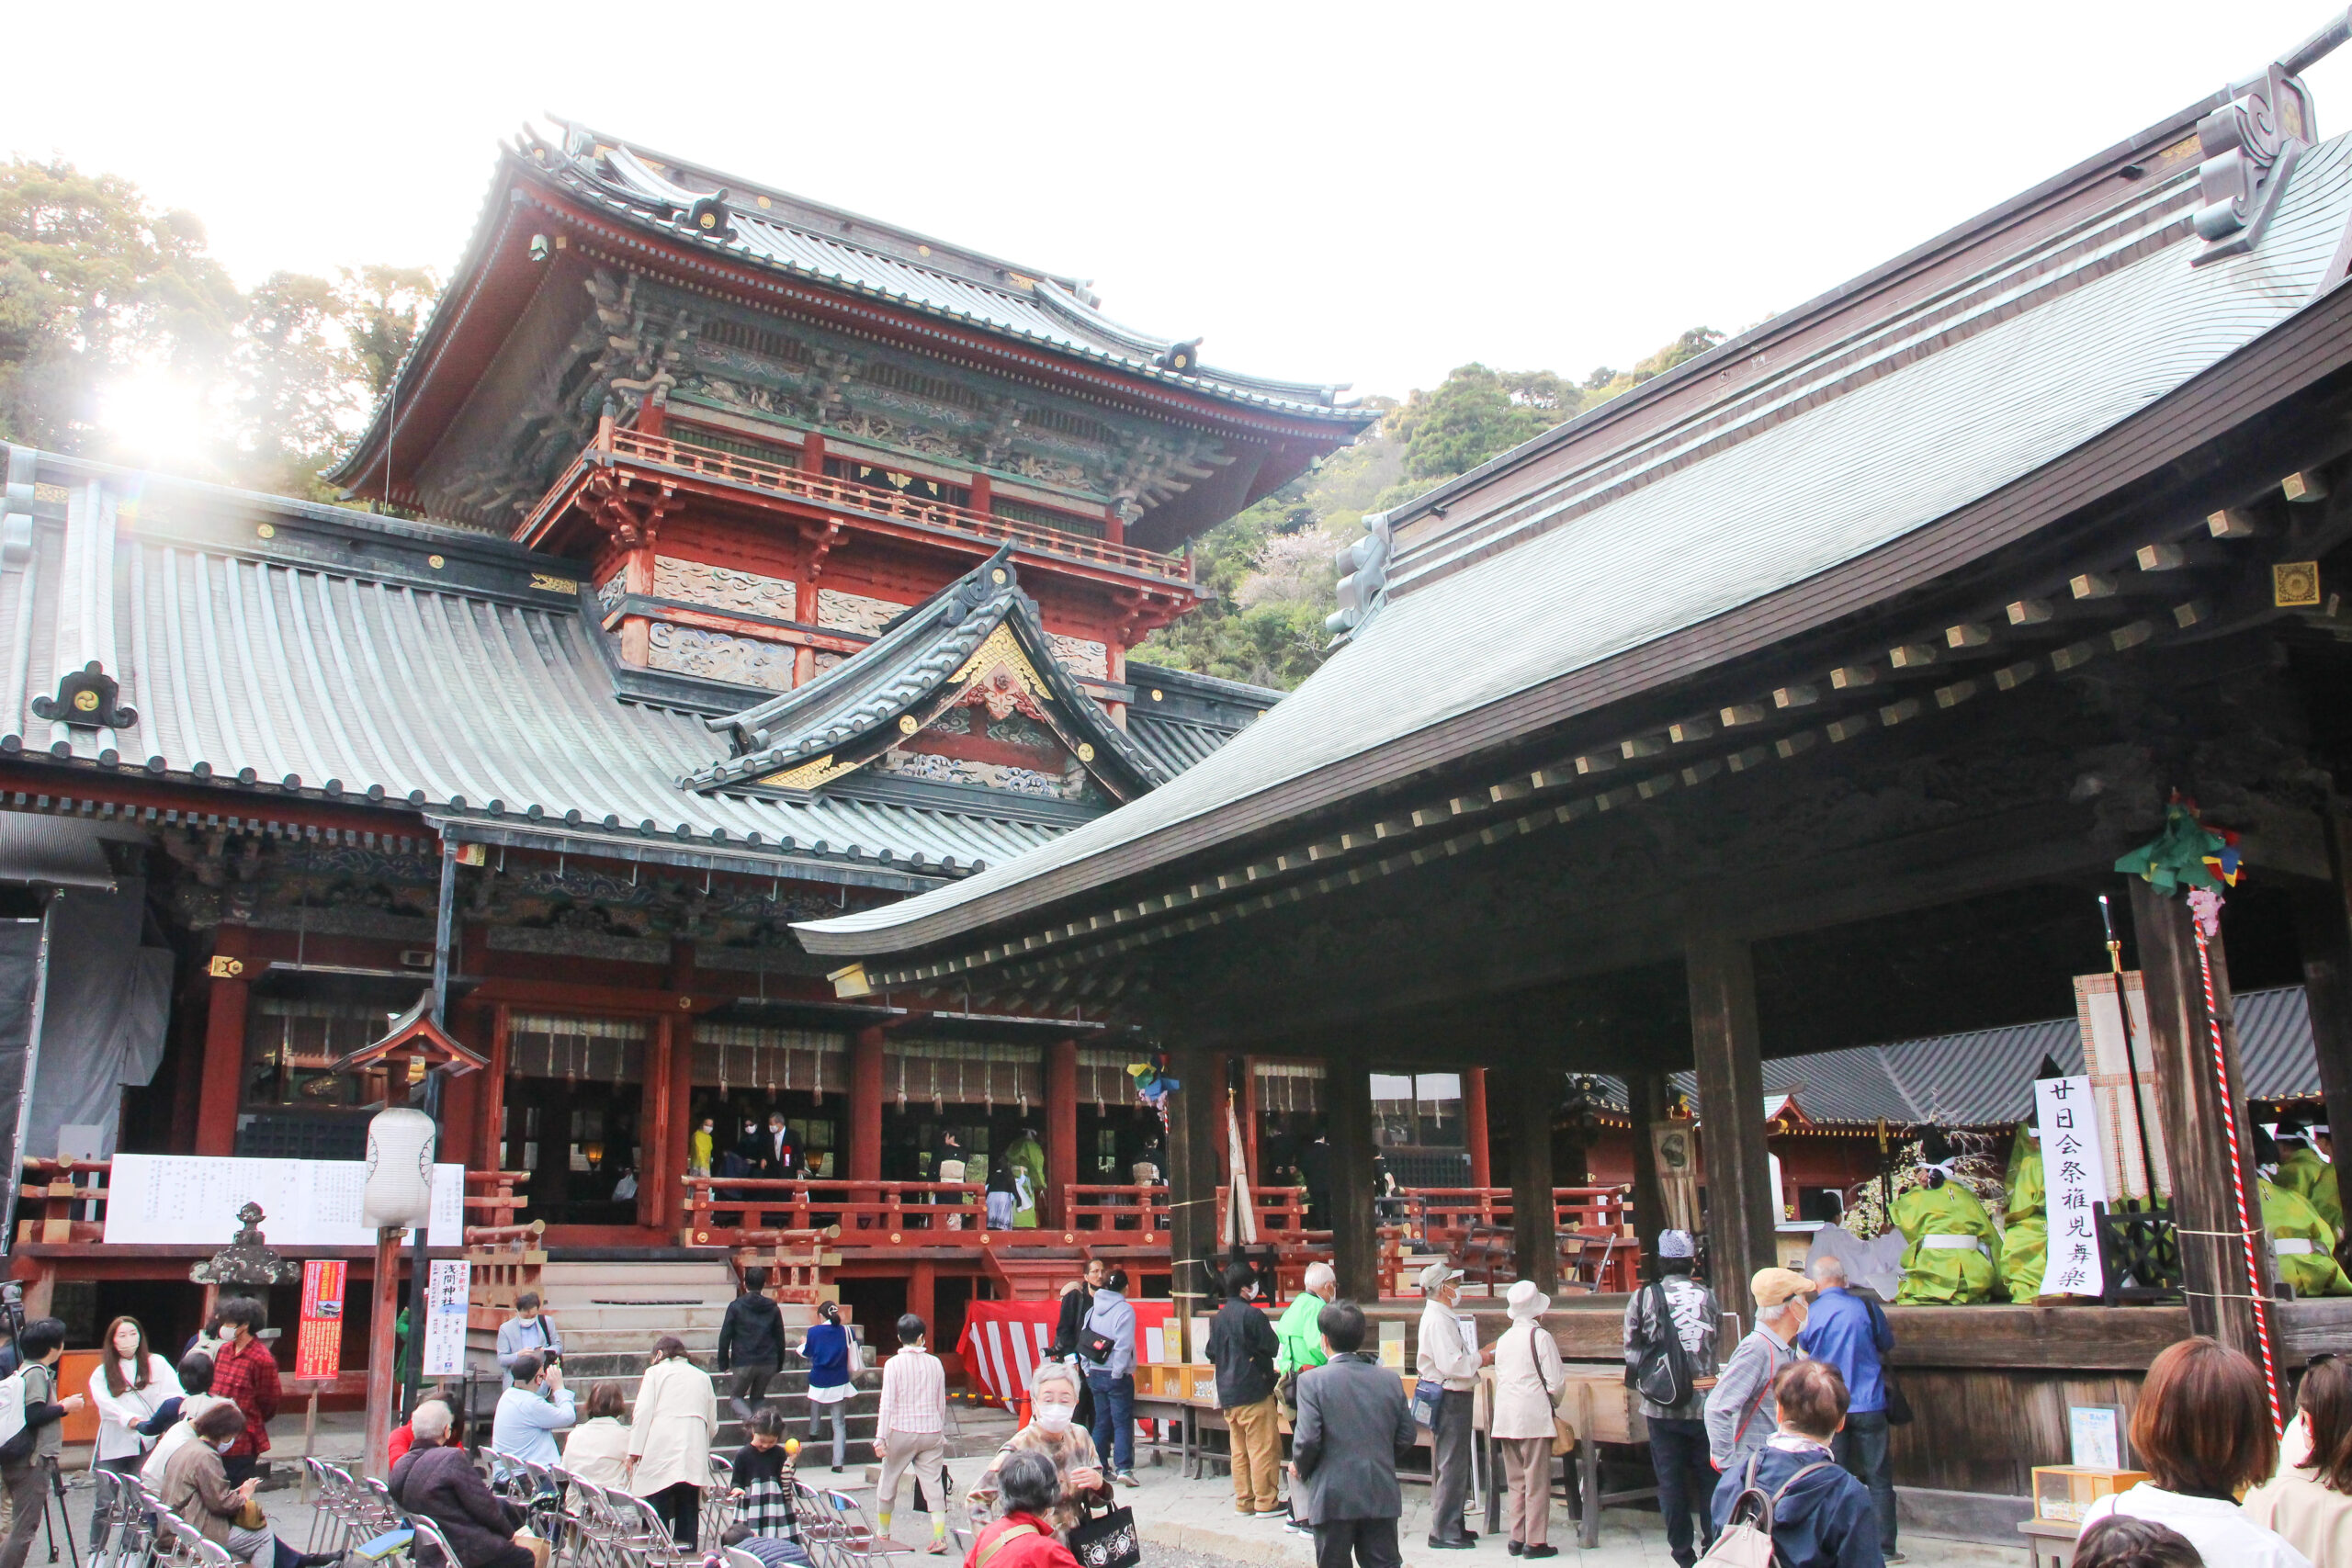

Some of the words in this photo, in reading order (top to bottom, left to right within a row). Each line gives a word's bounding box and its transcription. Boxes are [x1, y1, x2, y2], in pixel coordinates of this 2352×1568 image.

[2050, 1079, 2094, 1288] 廿日会祭稚児舞楽
